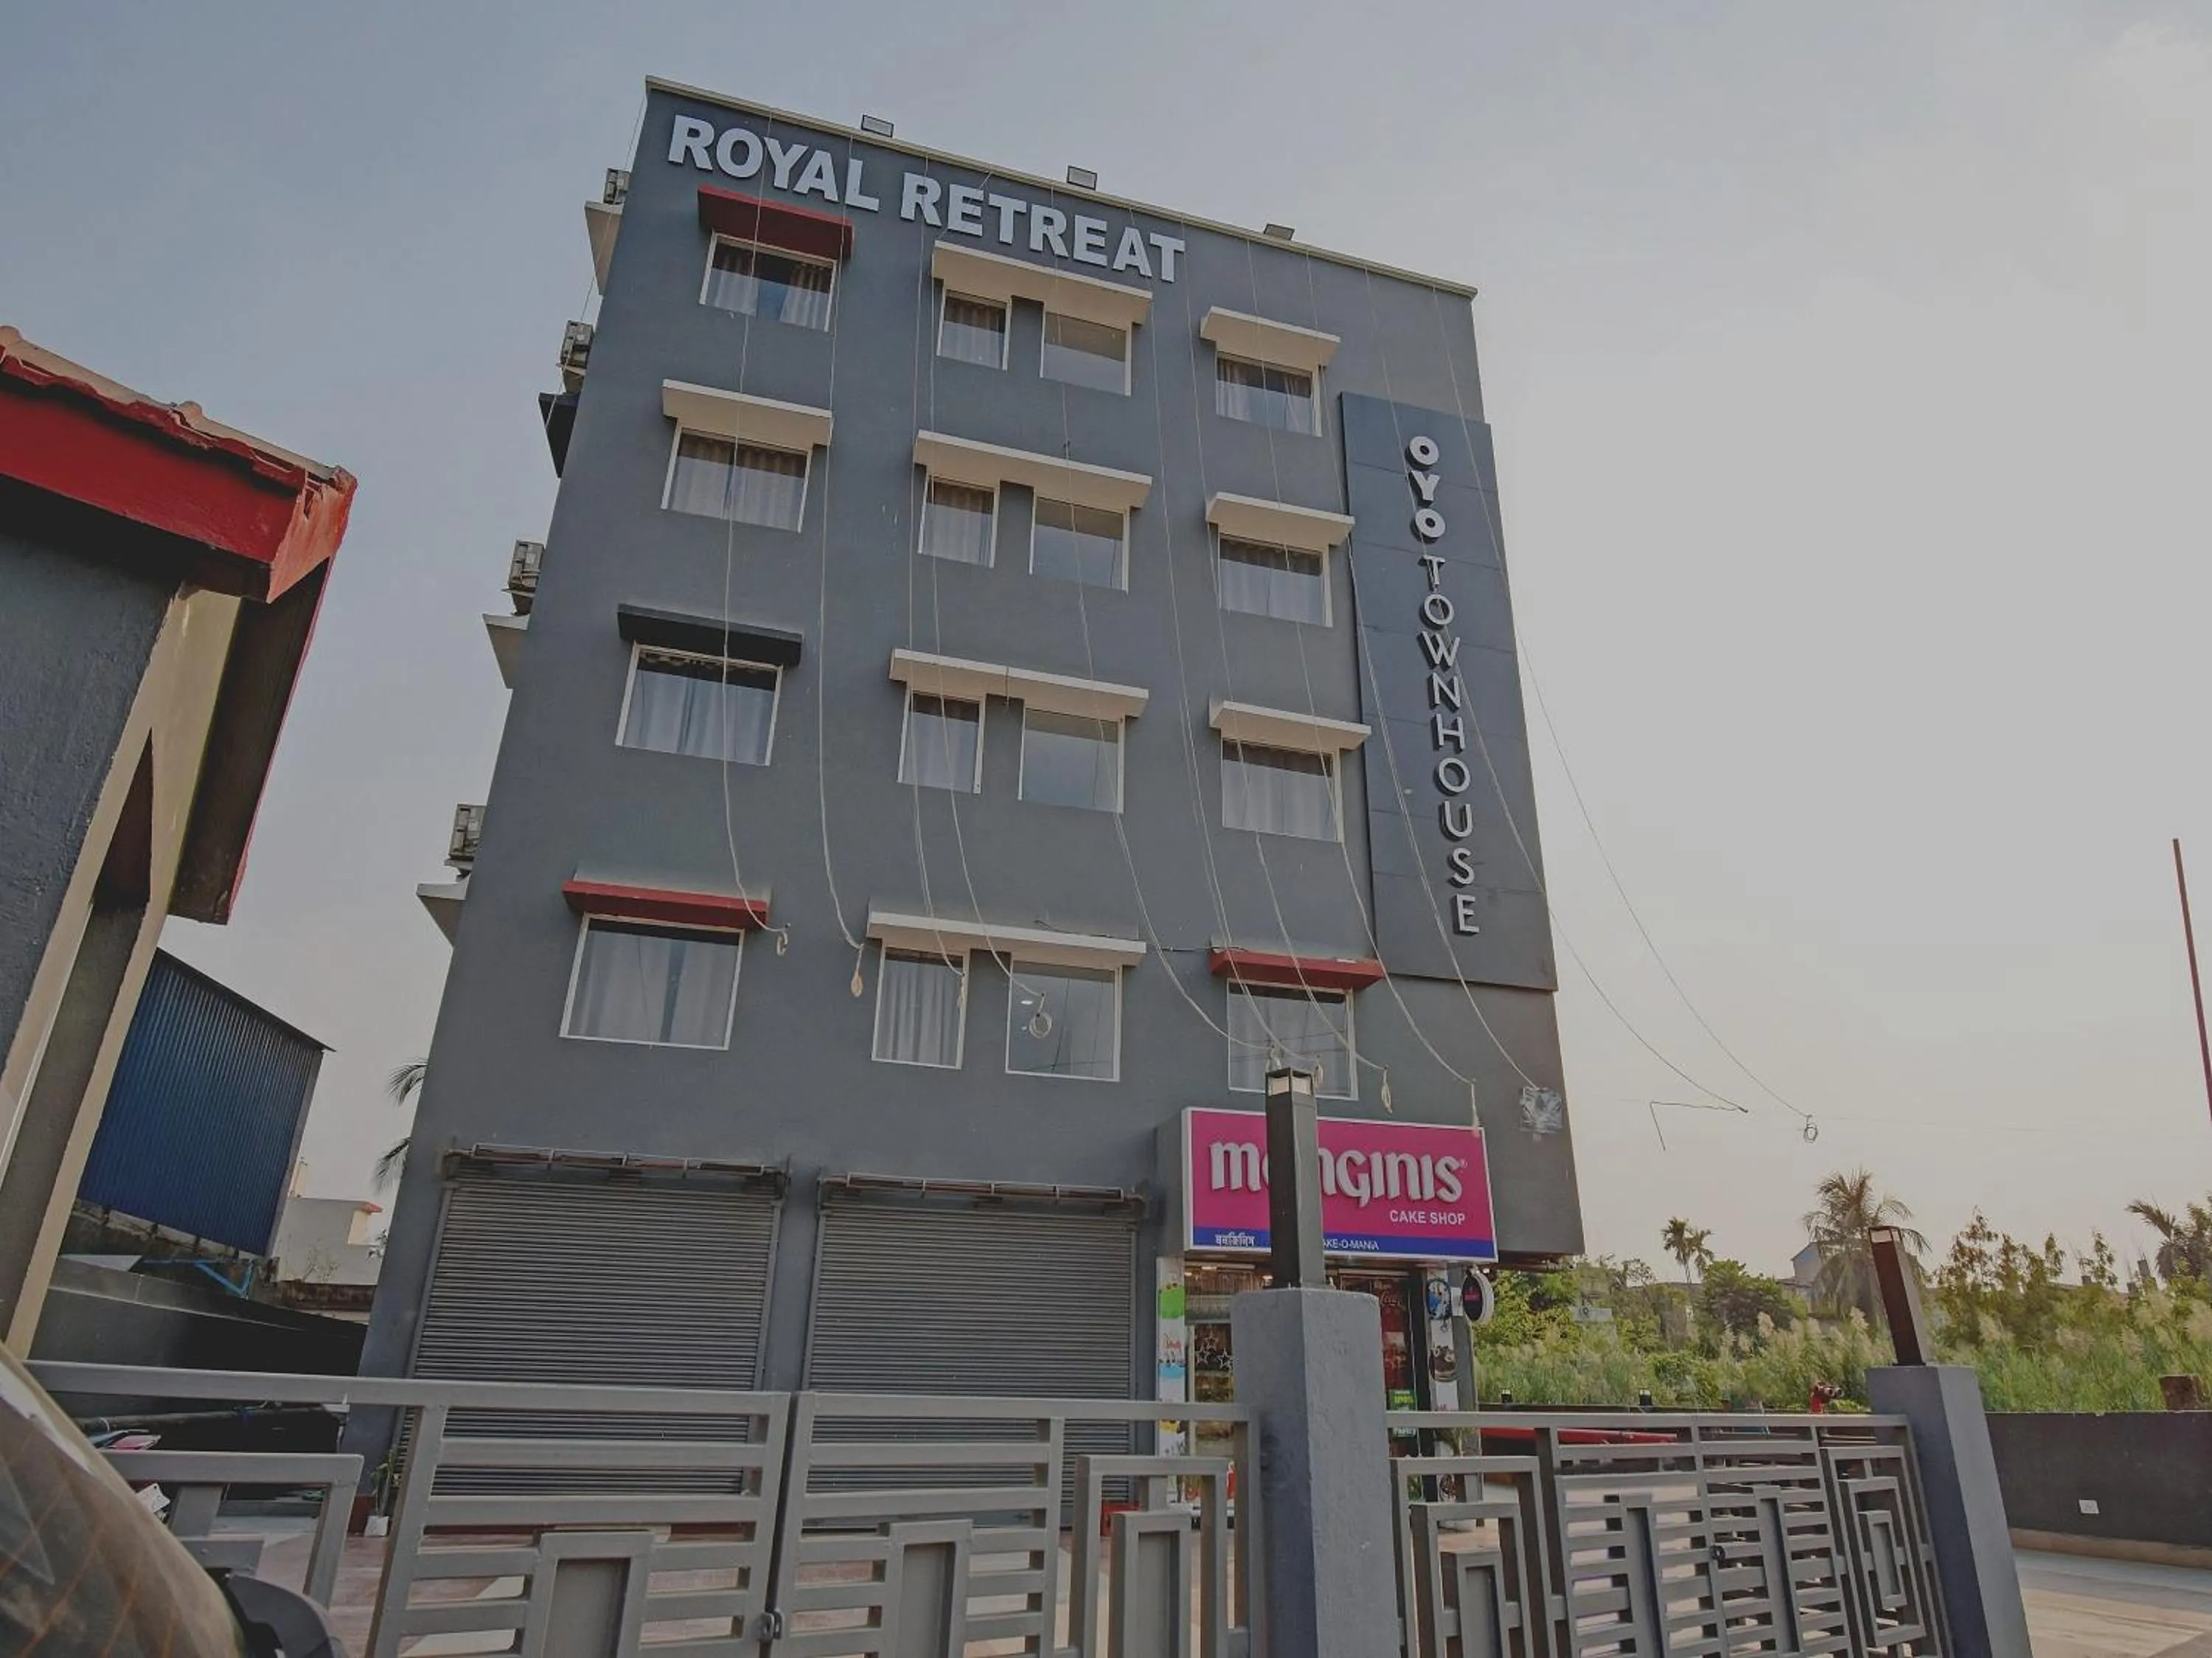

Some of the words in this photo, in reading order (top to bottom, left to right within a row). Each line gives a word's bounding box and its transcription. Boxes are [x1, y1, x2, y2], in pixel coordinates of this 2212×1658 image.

[667, 114, 880, 212] ROYAL
[900, 171, 1186, 283] RETREAT
[1408, 435, 1447, 541] OYO
[1418, 555, 1480, 934] TOWNHOUSE
[1209, 1141, 1464, 1208] MNGINIS
[1389, 1209, 1427, 1224] CAKE
[1429, 1211, 1466, 1226] SHOP
[1322, 1238, 1380, 1251] AKE-O-MANIA
